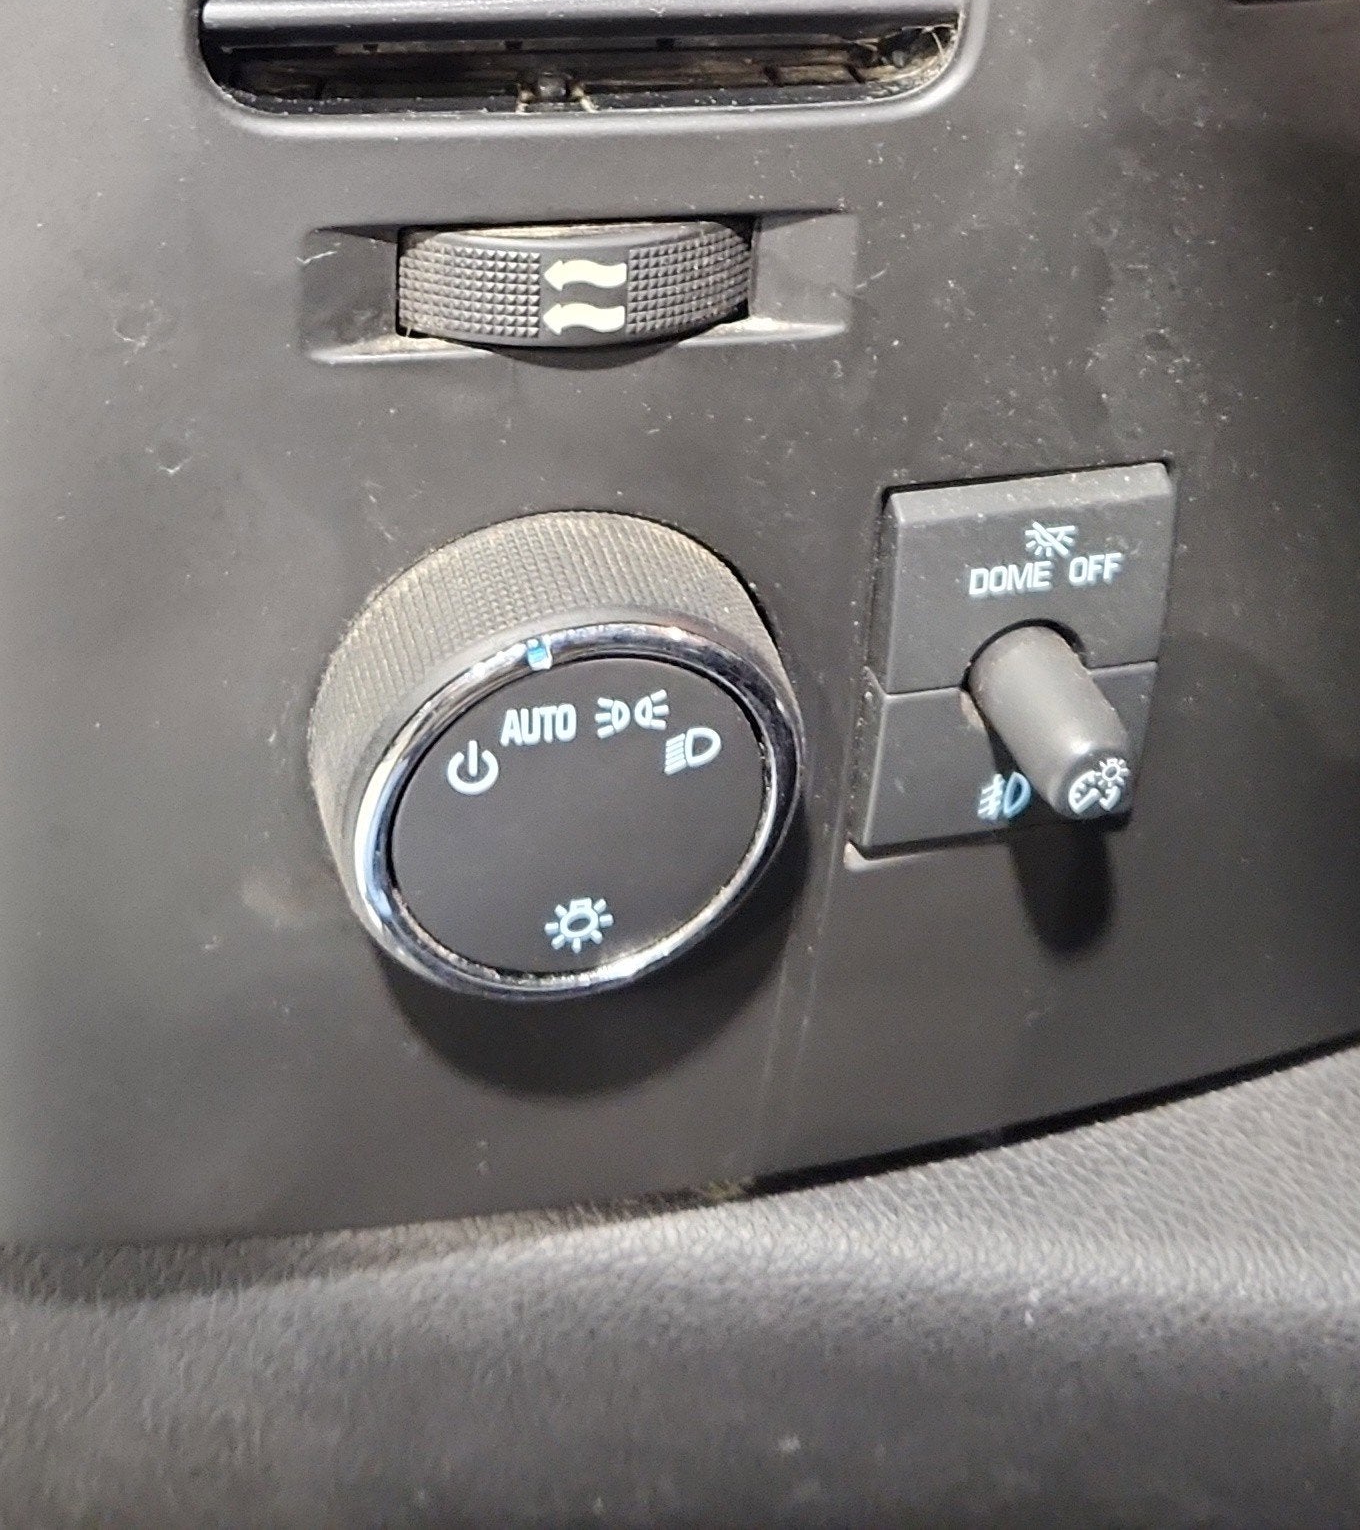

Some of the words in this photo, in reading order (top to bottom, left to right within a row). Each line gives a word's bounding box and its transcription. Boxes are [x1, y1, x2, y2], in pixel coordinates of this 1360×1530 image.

[968, 559, 1053, 598] DOME
[1068, 551, 1124, 587] OFF
[499, 702, 577, 748] AUTO
